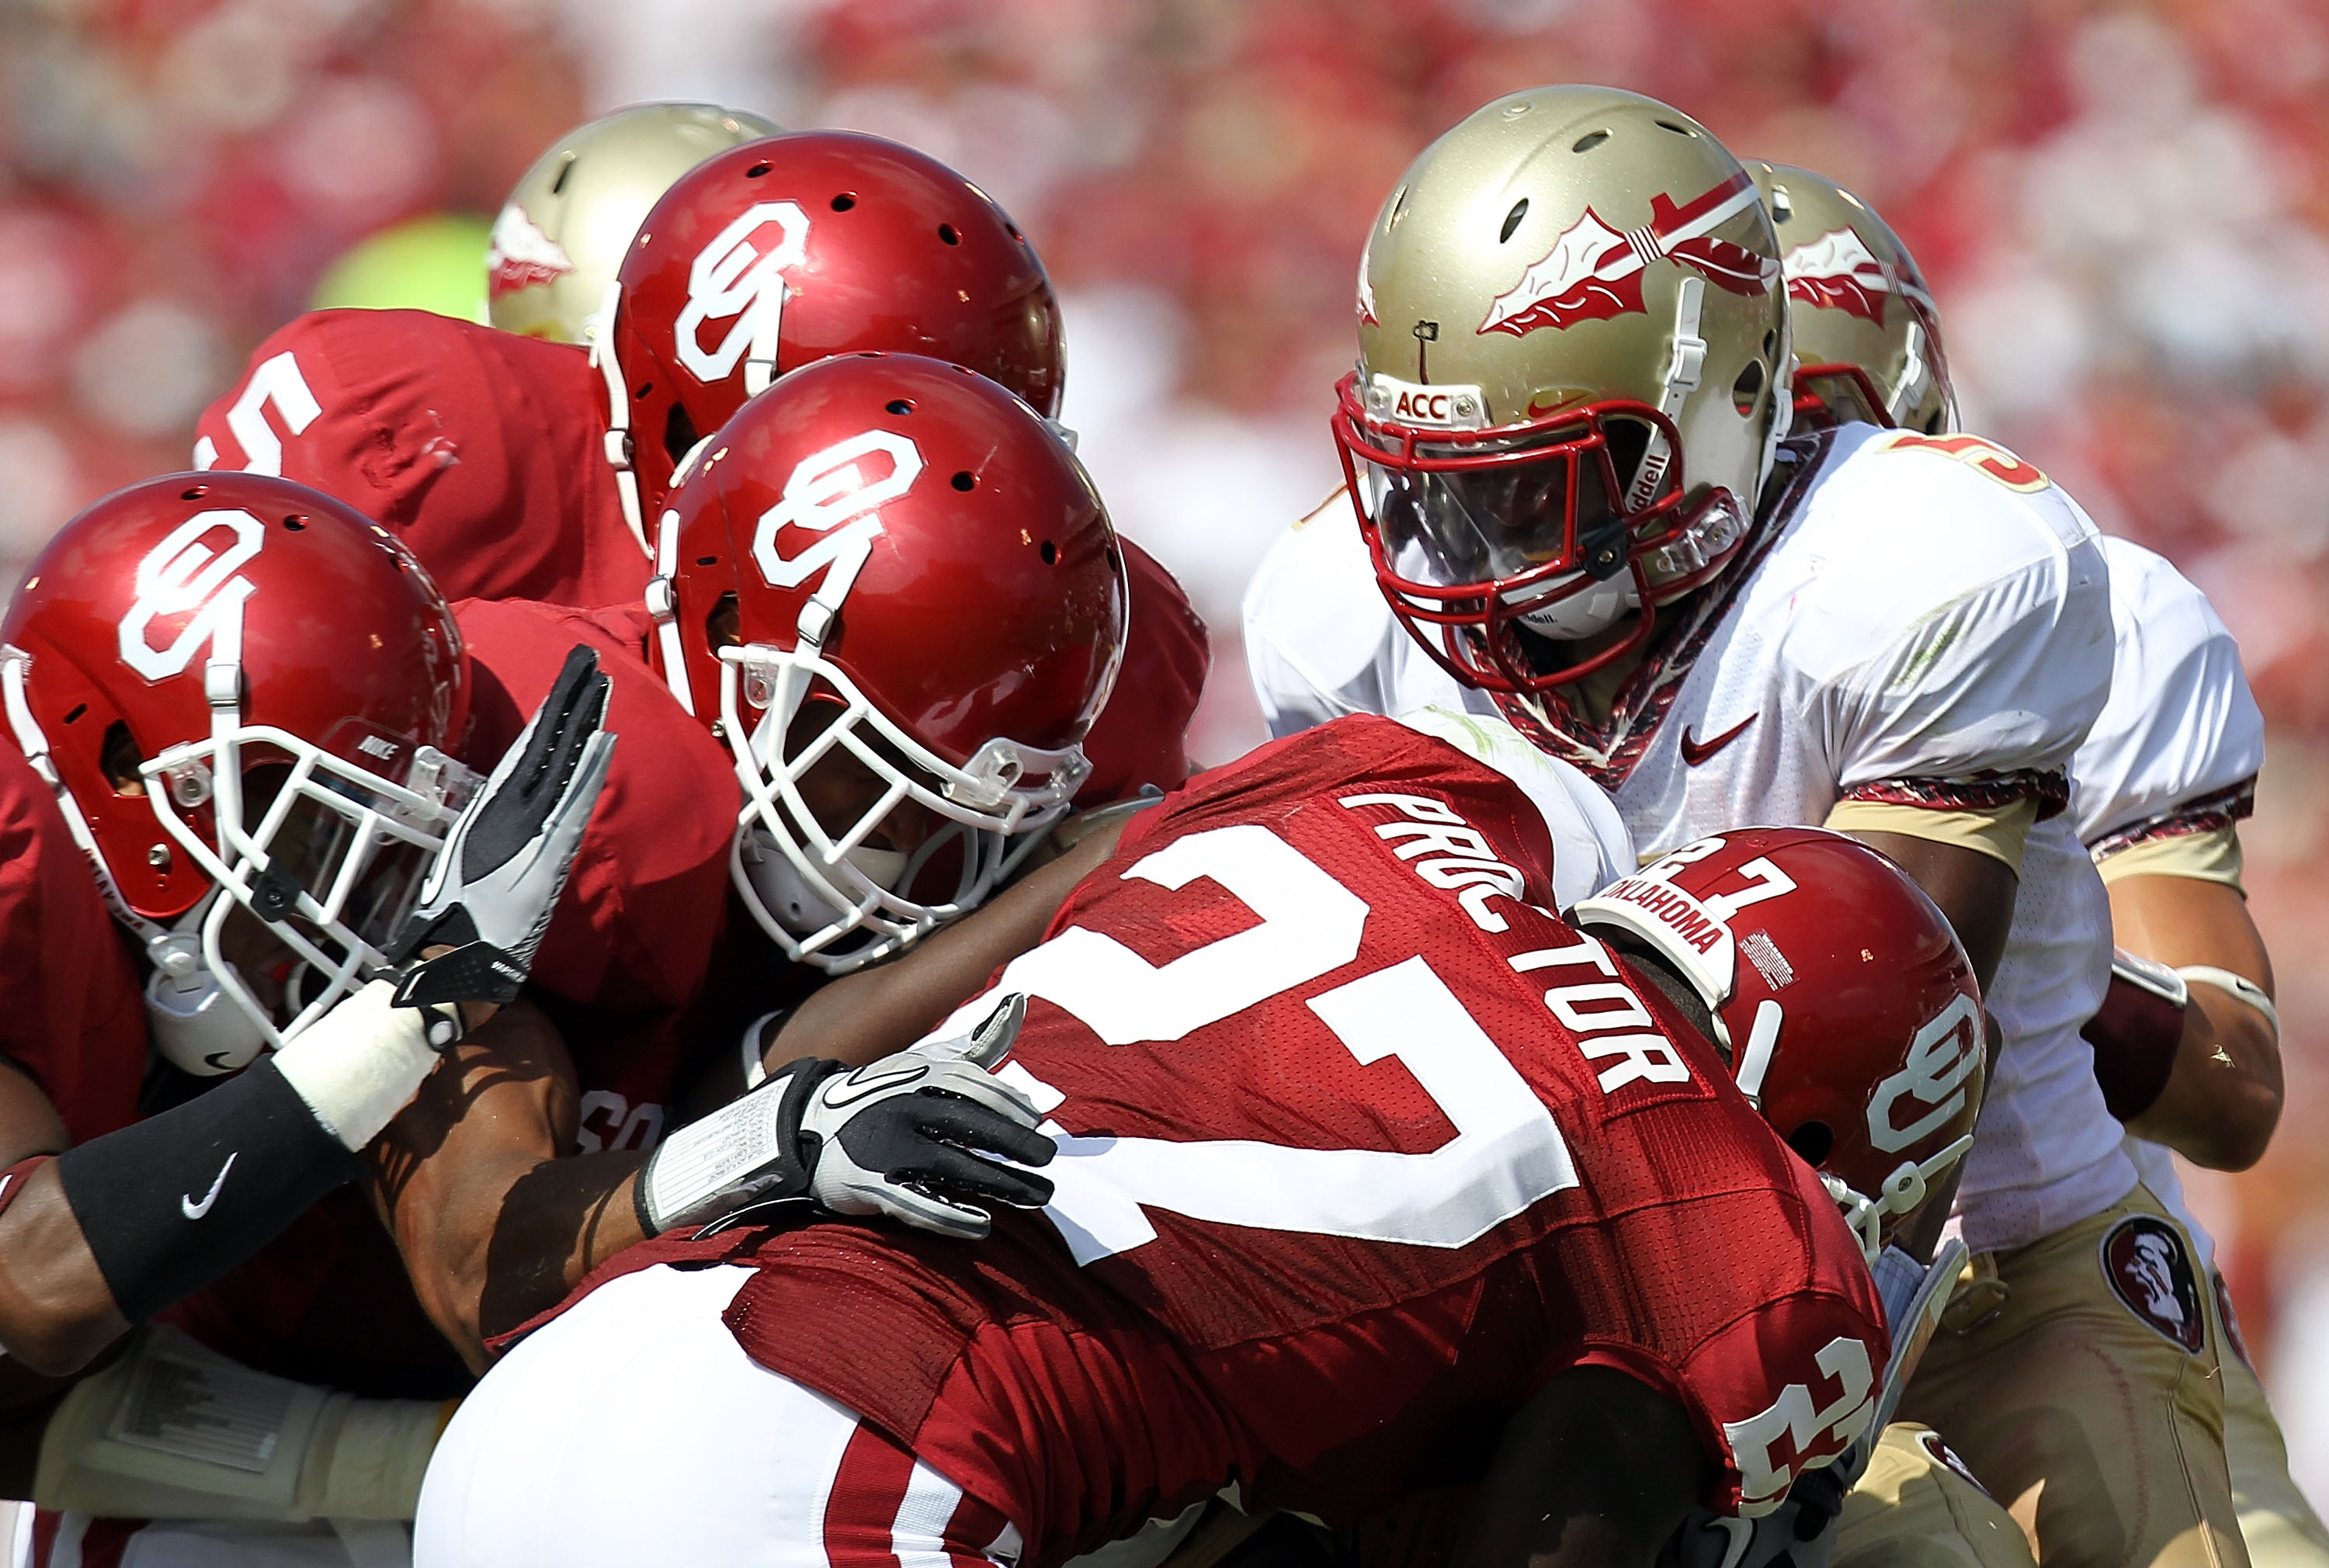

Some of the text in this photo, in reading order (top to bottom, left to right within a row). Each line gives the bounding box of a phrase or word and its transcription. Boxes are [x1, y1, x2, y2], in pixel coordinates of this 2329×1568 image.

[1396, 391, 1448, 420] ACC
[1631, 455, 1666, 509] ddell
[1600, 879, 1724, 956] OKLAHOMA
[1636, 837, 1799, 923] 27
[1338, 793, 1691, 1094] PROCTOR
[907, 824, 1581, 1268] 27
